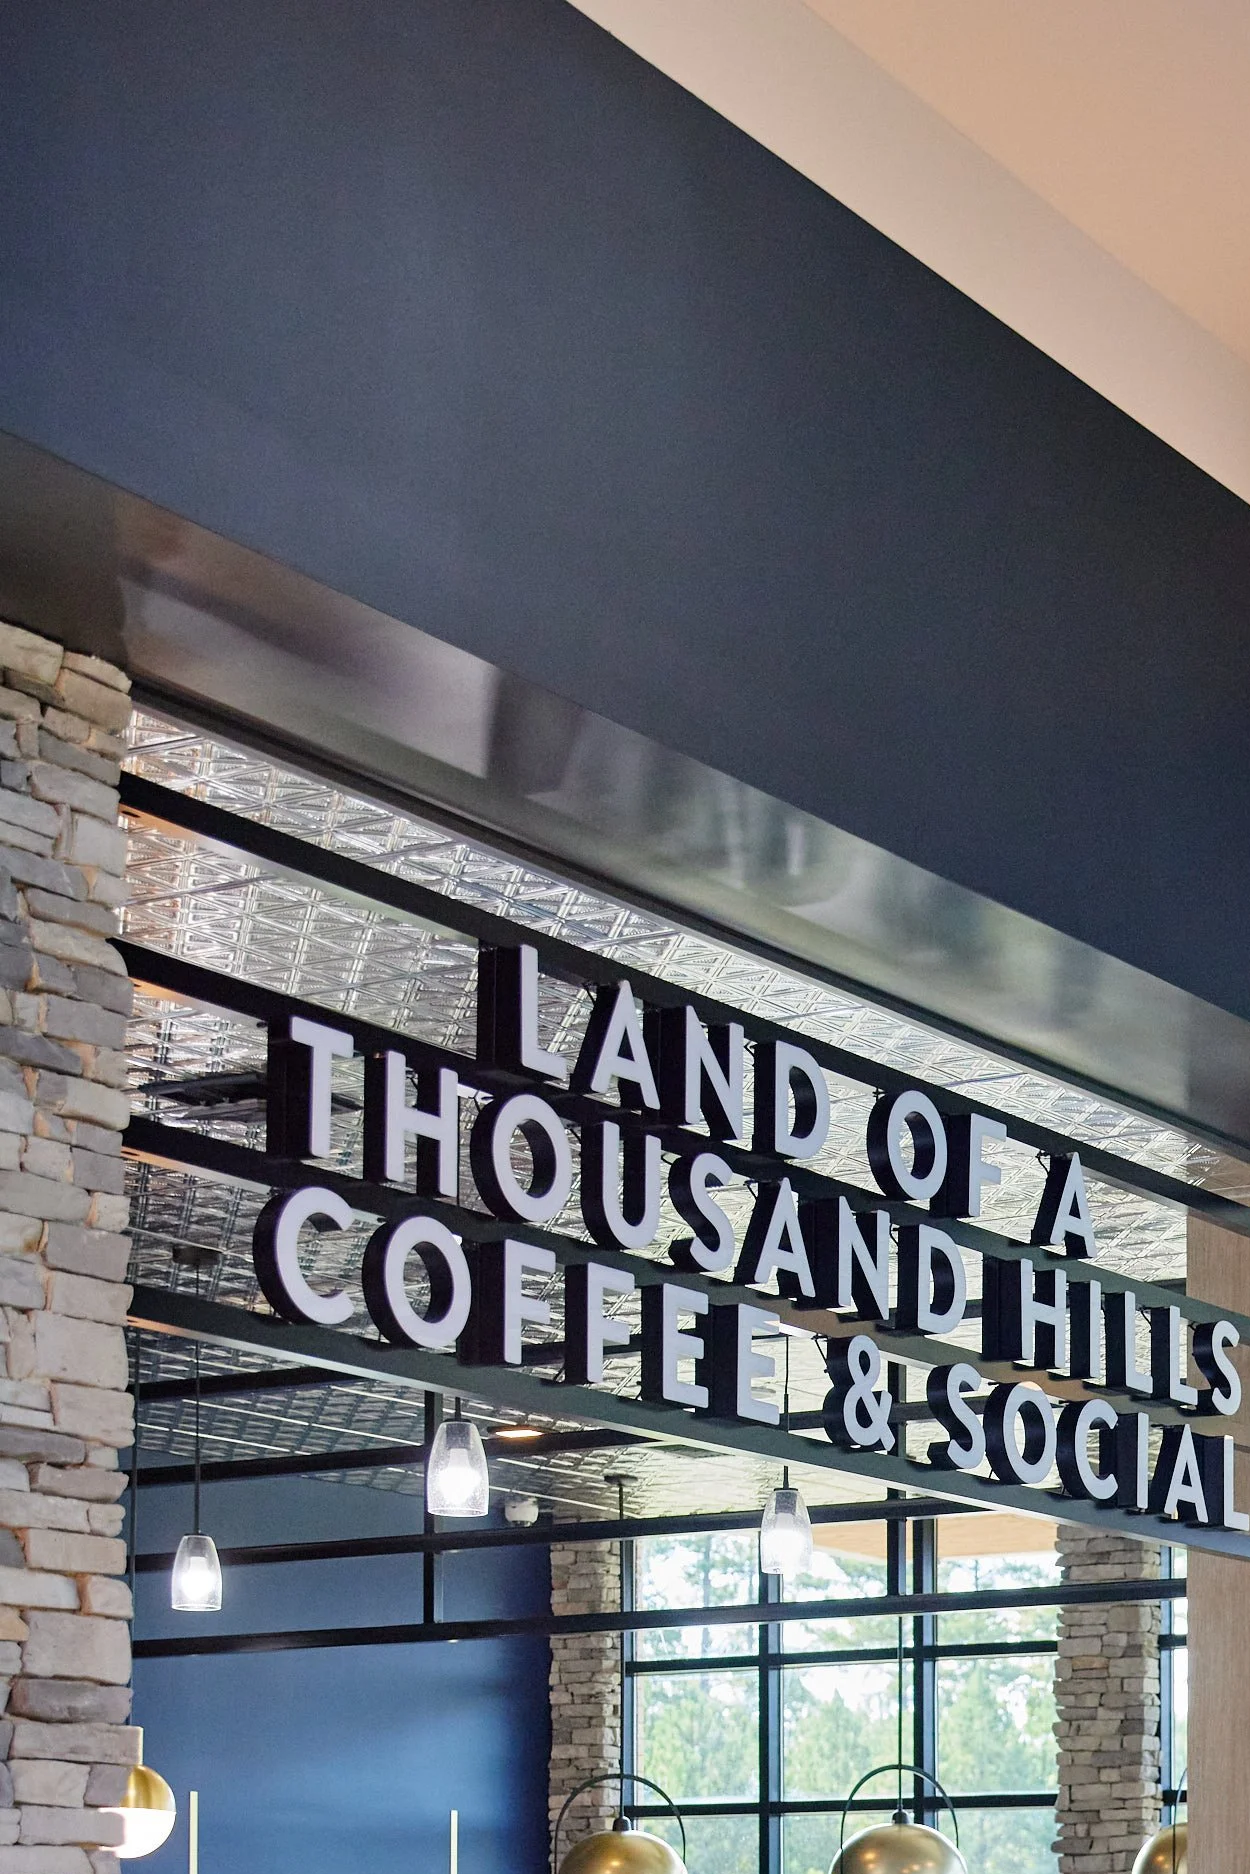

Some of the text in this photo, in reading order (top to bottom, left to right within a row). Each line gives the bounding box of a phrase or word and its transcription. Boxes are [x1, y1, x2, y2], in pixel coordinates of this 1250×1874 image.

[289, 1015, 1242, 1416] THOUSAND HILLS
[520, 944, 1097, 1258] LAND OF A
[275, 1186, 1250, 1532] COFFEE & SOCIAL
